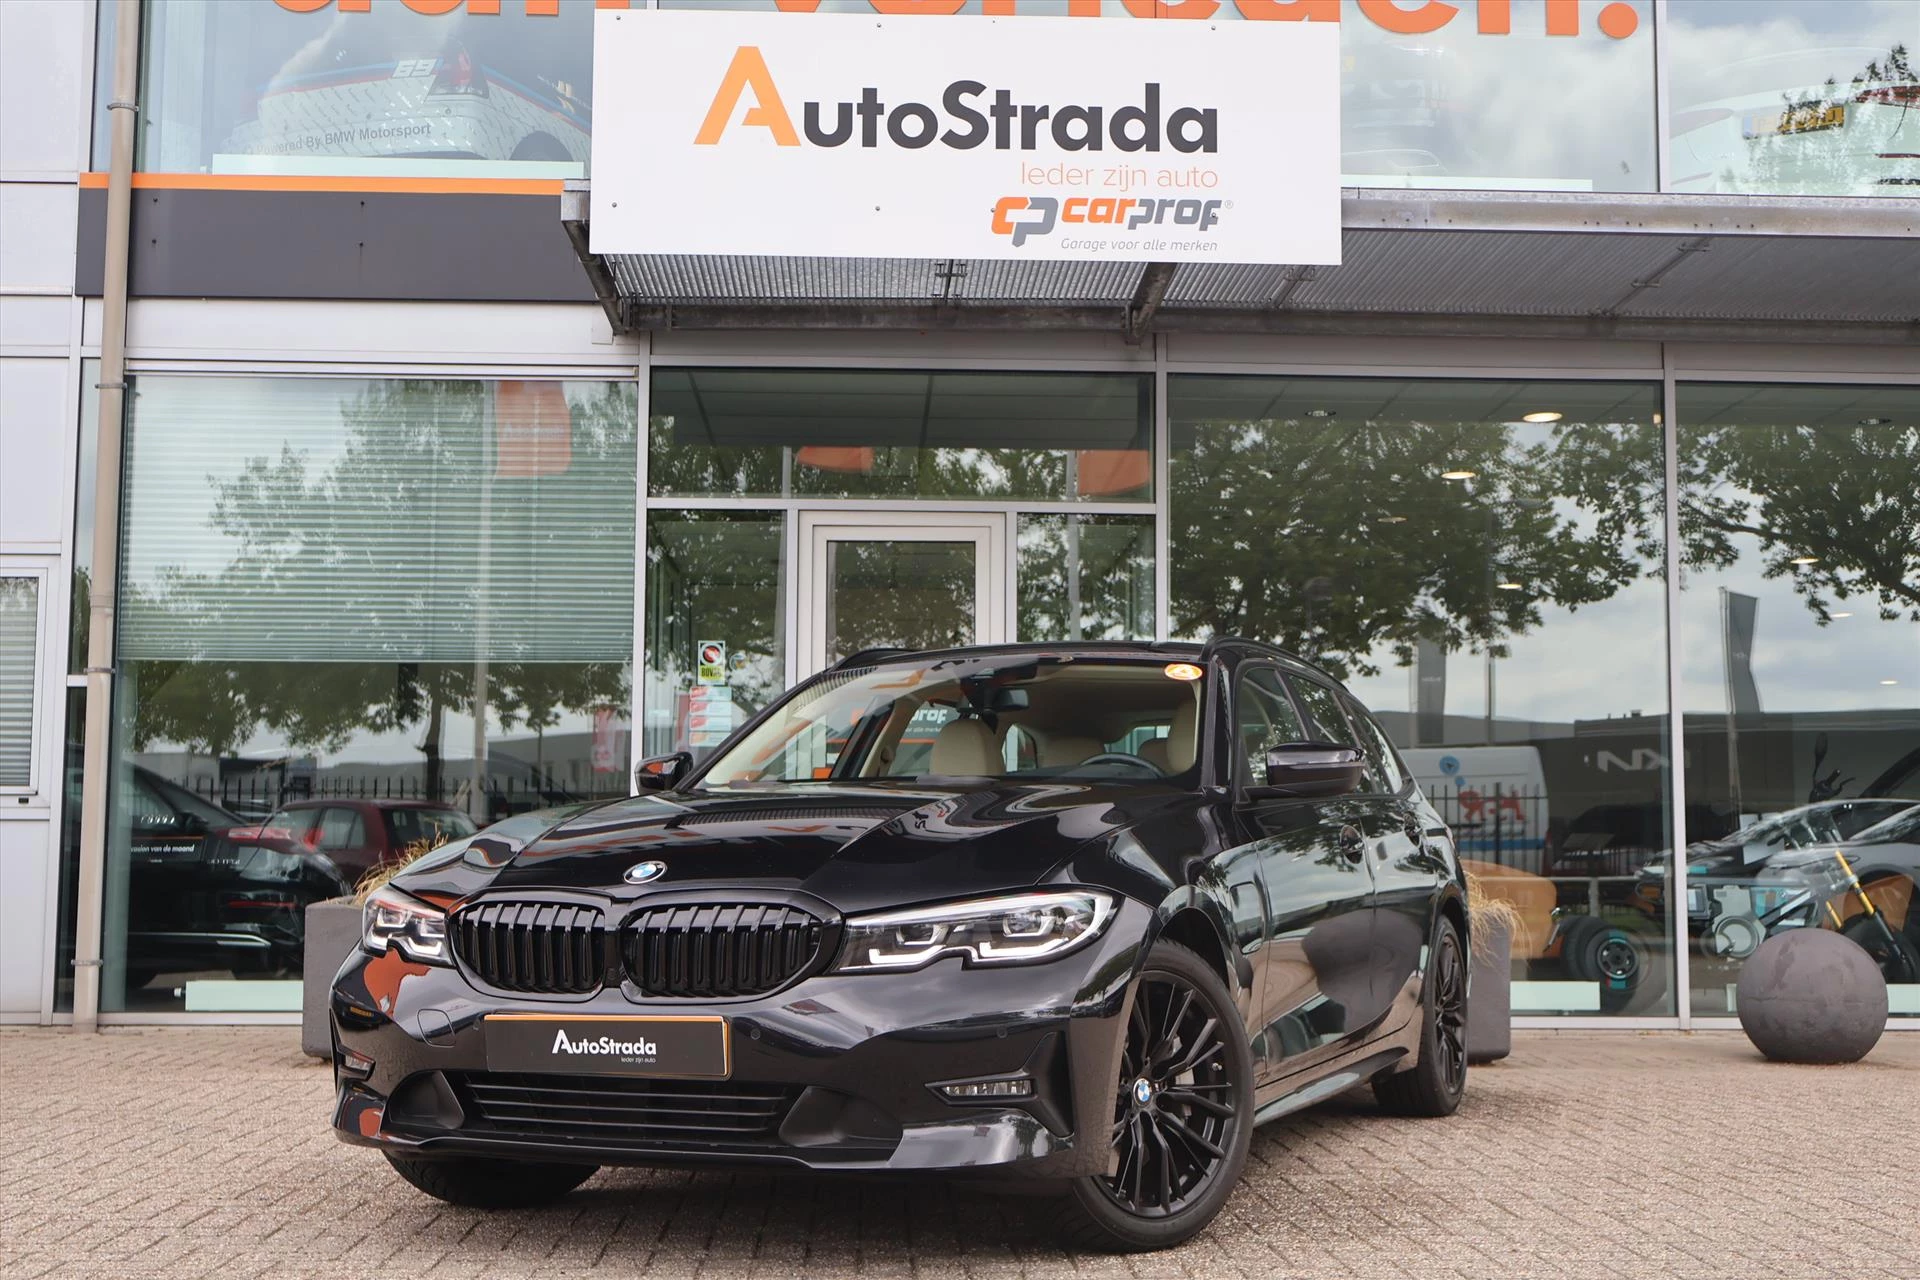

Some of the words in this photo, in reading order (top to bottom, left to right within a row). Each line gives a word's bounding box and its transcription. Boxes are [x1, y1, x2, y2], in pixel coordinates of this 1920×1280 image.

[393, 59, 437, 79] 69
[694, 45, 1218, 153] AutoStrada
[306, 134, 321, 150] By
[325, 129, 355, 146] BMW
[359, 122, 431, 142] Motorsport
[1021, 162, 1094, 186] Ieder
[1103, 164, 1147, 192] zijn
[1157, 165, 1219, 188] auto
[1061, 197, 1222, 232] carprof
[1061, 238, 1107, 253] Garage
[1111, 240, 1141, 251] voor
[1143, 238, 1167, 251] alle
[1170, 239, 1218, 252] merken
[552, 1029, 656, 1055] AutoStrada
